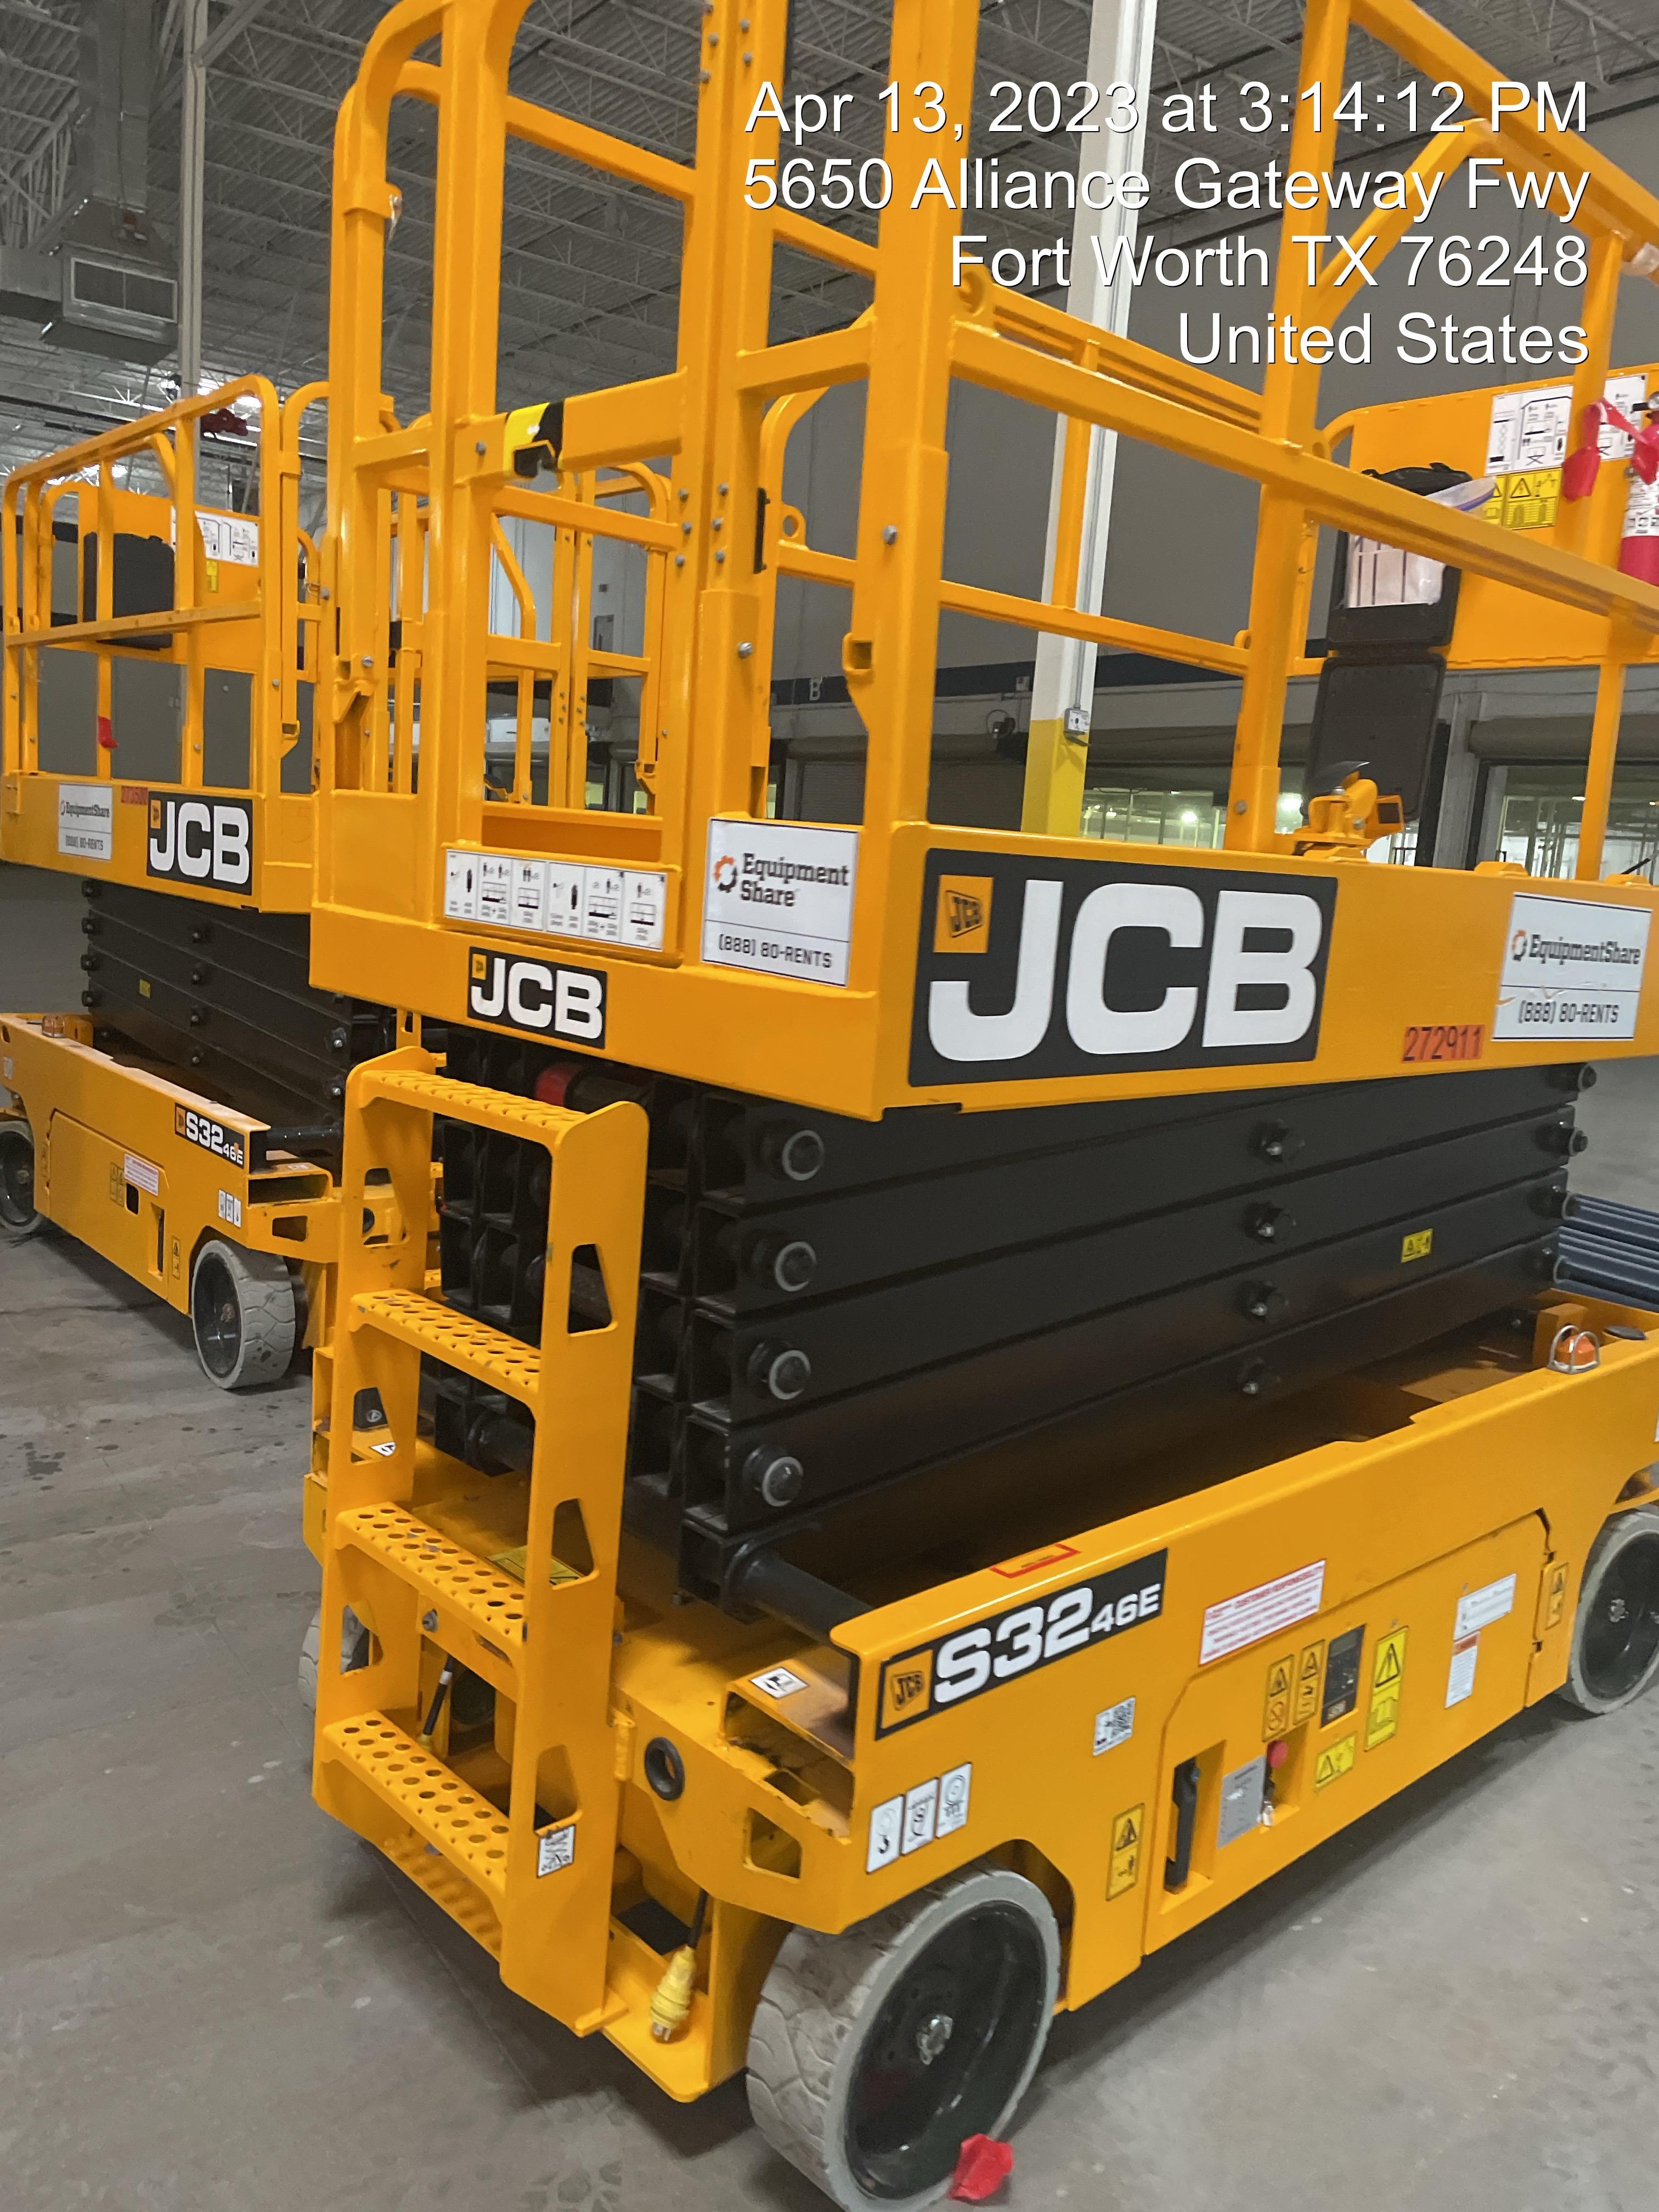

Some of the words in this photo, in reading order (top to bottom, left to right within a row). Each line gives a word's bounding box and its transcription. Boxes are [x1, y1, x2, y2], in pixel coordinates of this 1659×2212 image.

[150, 801, 250, 884] JCB
[743, 852, 849, 886] Equipment
[740, 879, 795, 907] Share
[718, 933, 756, 956] (888)
[760, 941, 833, 968] 80-RENTS
[1528, 934, 1641, 965] EquipmentShare
[928, 880, 1322, 1061] JCB
[471, 957, 603, 1039] JCB
[1518, 1000, 1556, 1024] (888)
[1559, 1002, 1620, 1023] 80-RENTS
[1403, 1025, 1481, 1061] 272911
